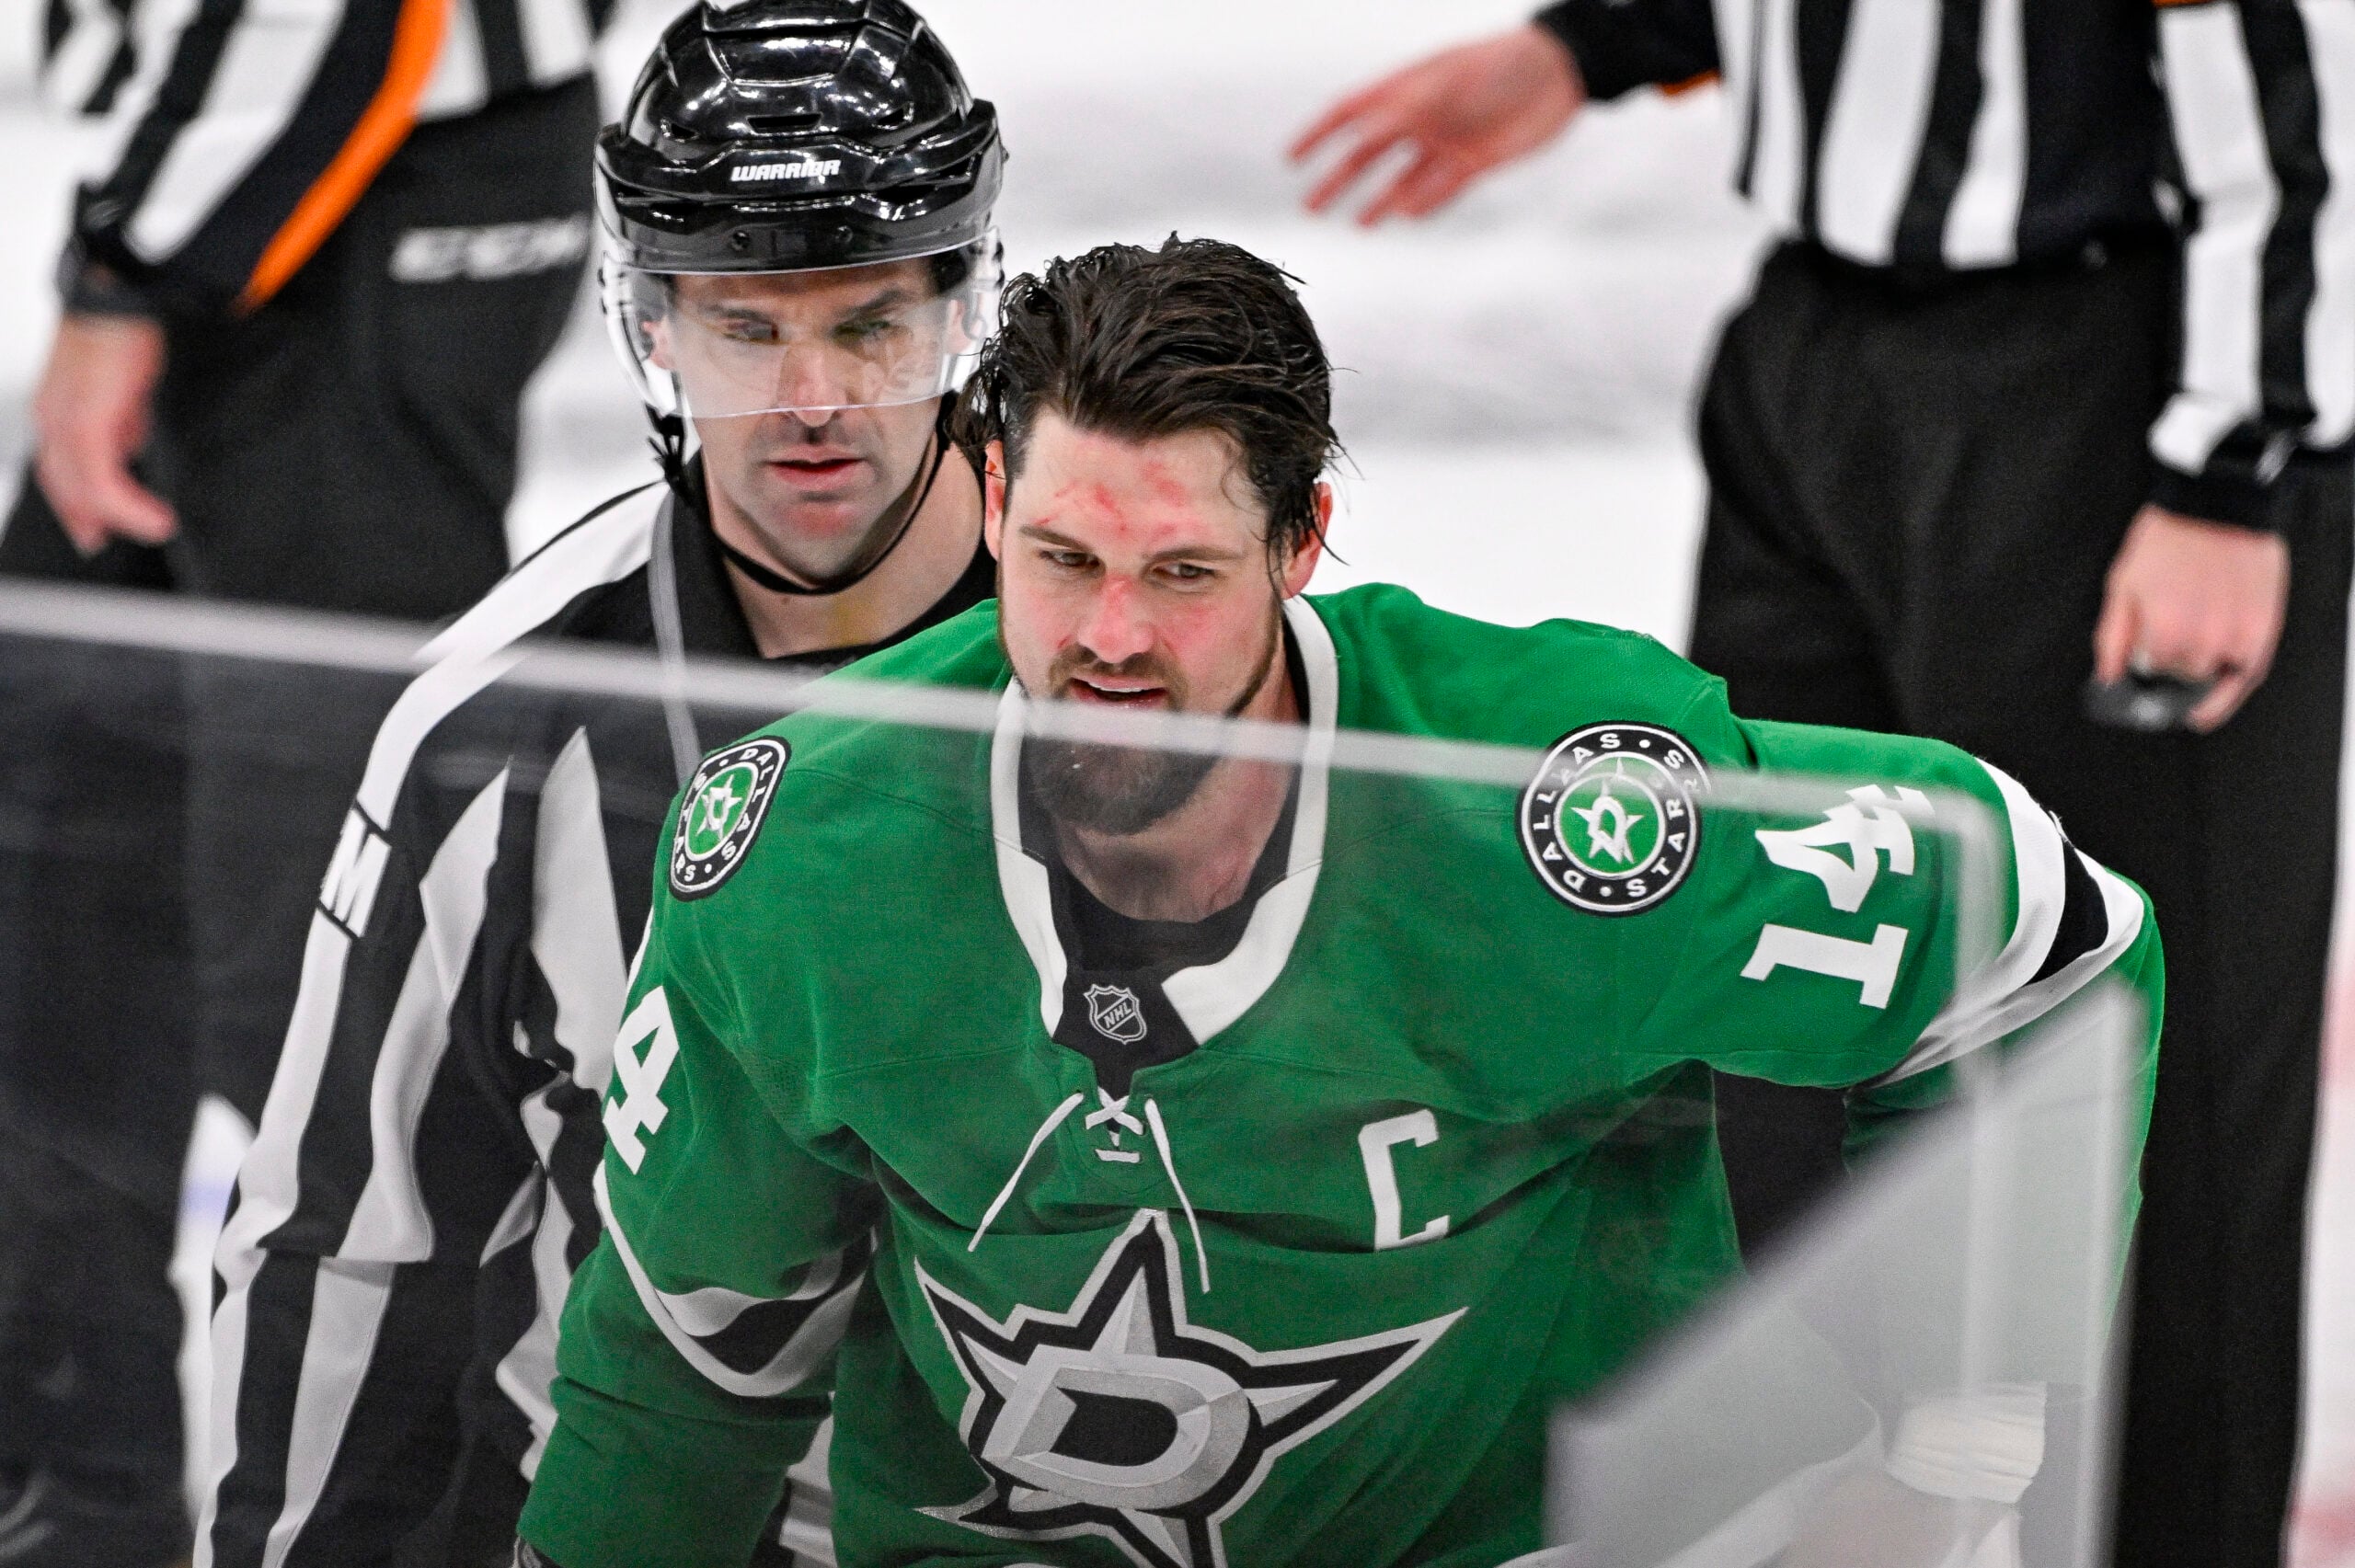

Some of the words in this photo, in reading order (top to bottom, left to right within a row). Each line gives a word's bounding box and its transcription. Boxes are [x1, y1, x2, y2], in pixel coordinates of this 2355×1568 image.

[729, 160, 841, 181] WARRIOR
[721, 749, 775, 861] DALLAS
[1534, 733, 1622, 893] DALLAS
[1626, 750, 1700, 898] STARS
[1740, 784, 1935, 1010] 14
[1104, 1002, 1132, 1028] NHL
[1358, 1109, 1450, 1251] C
